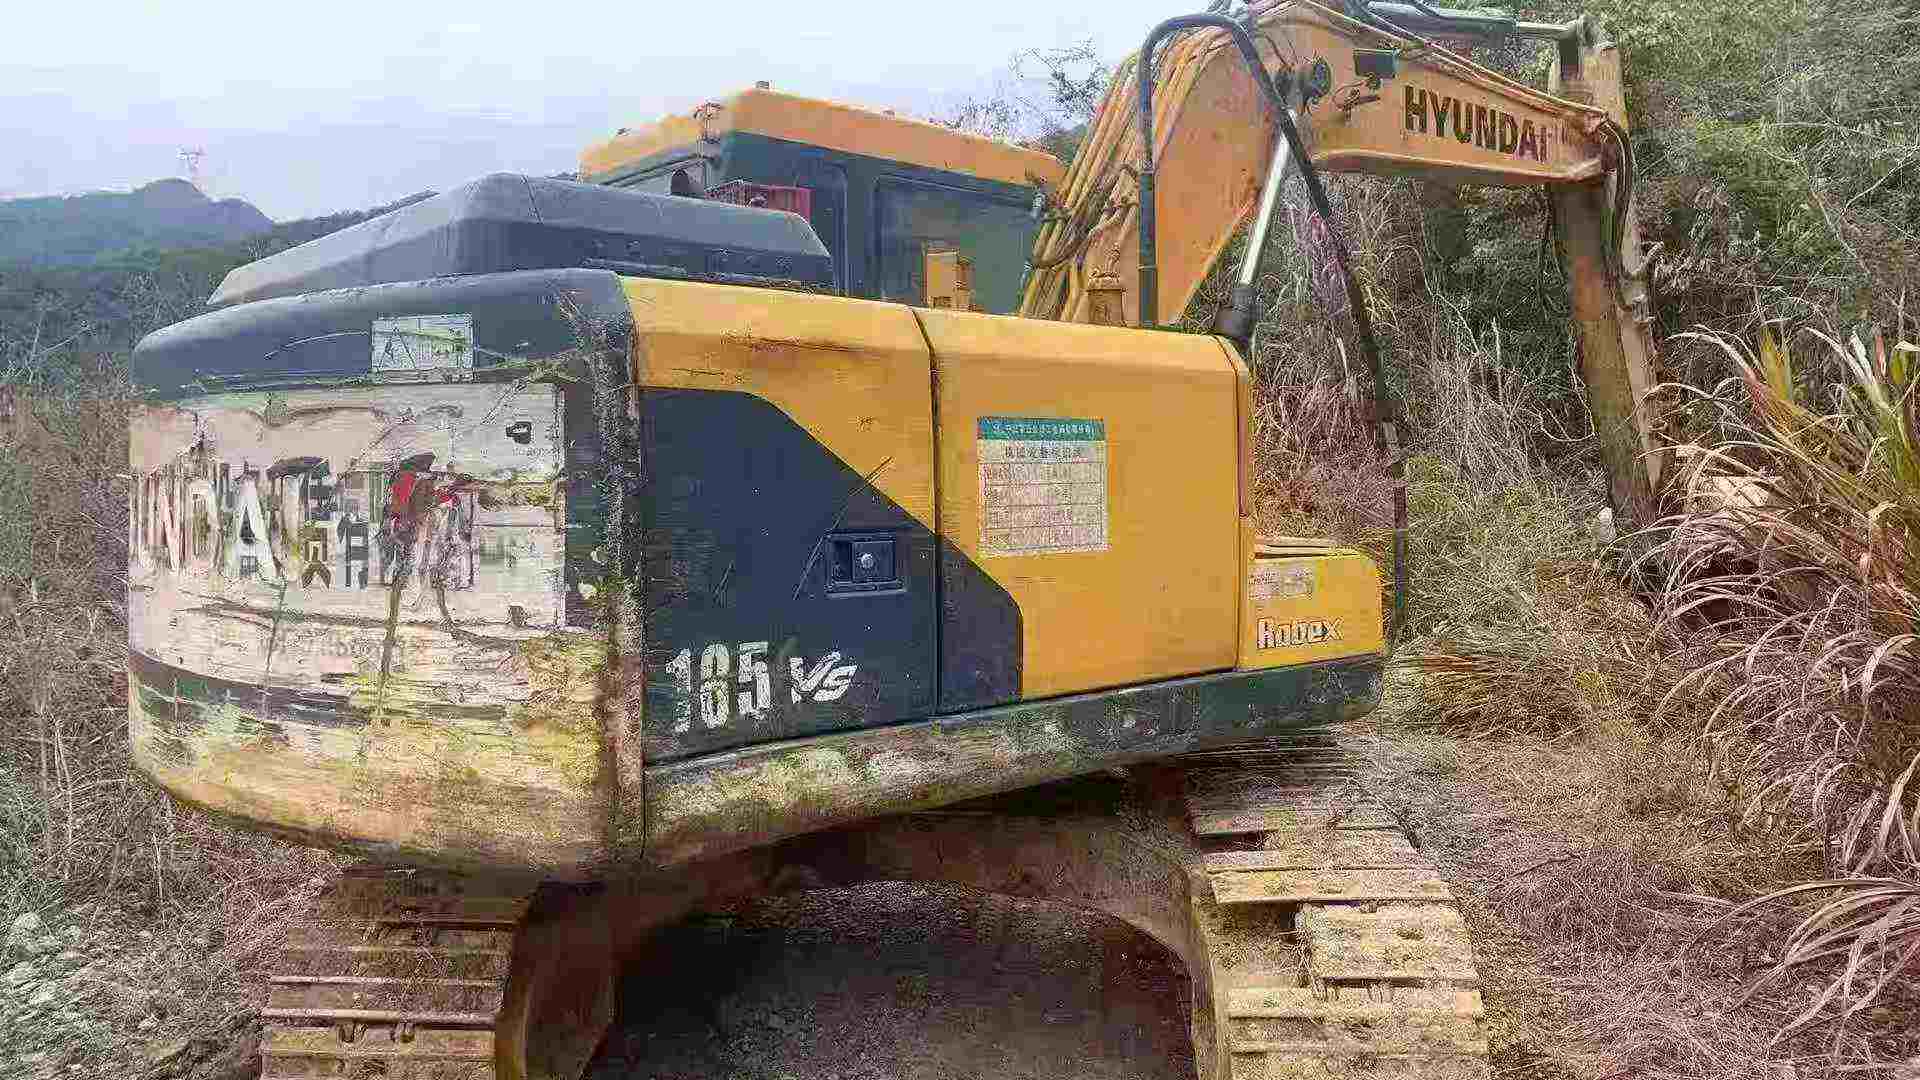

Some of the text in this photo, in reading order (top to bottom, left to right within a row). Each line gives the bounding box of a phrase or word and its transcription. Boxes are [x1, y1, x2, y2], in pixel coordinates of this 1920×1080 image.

[1404, 85, 1548, 162] HYUNDAI
[1257, 616, 1344, 651] Robex
[665, 641, 772, 733] 185
